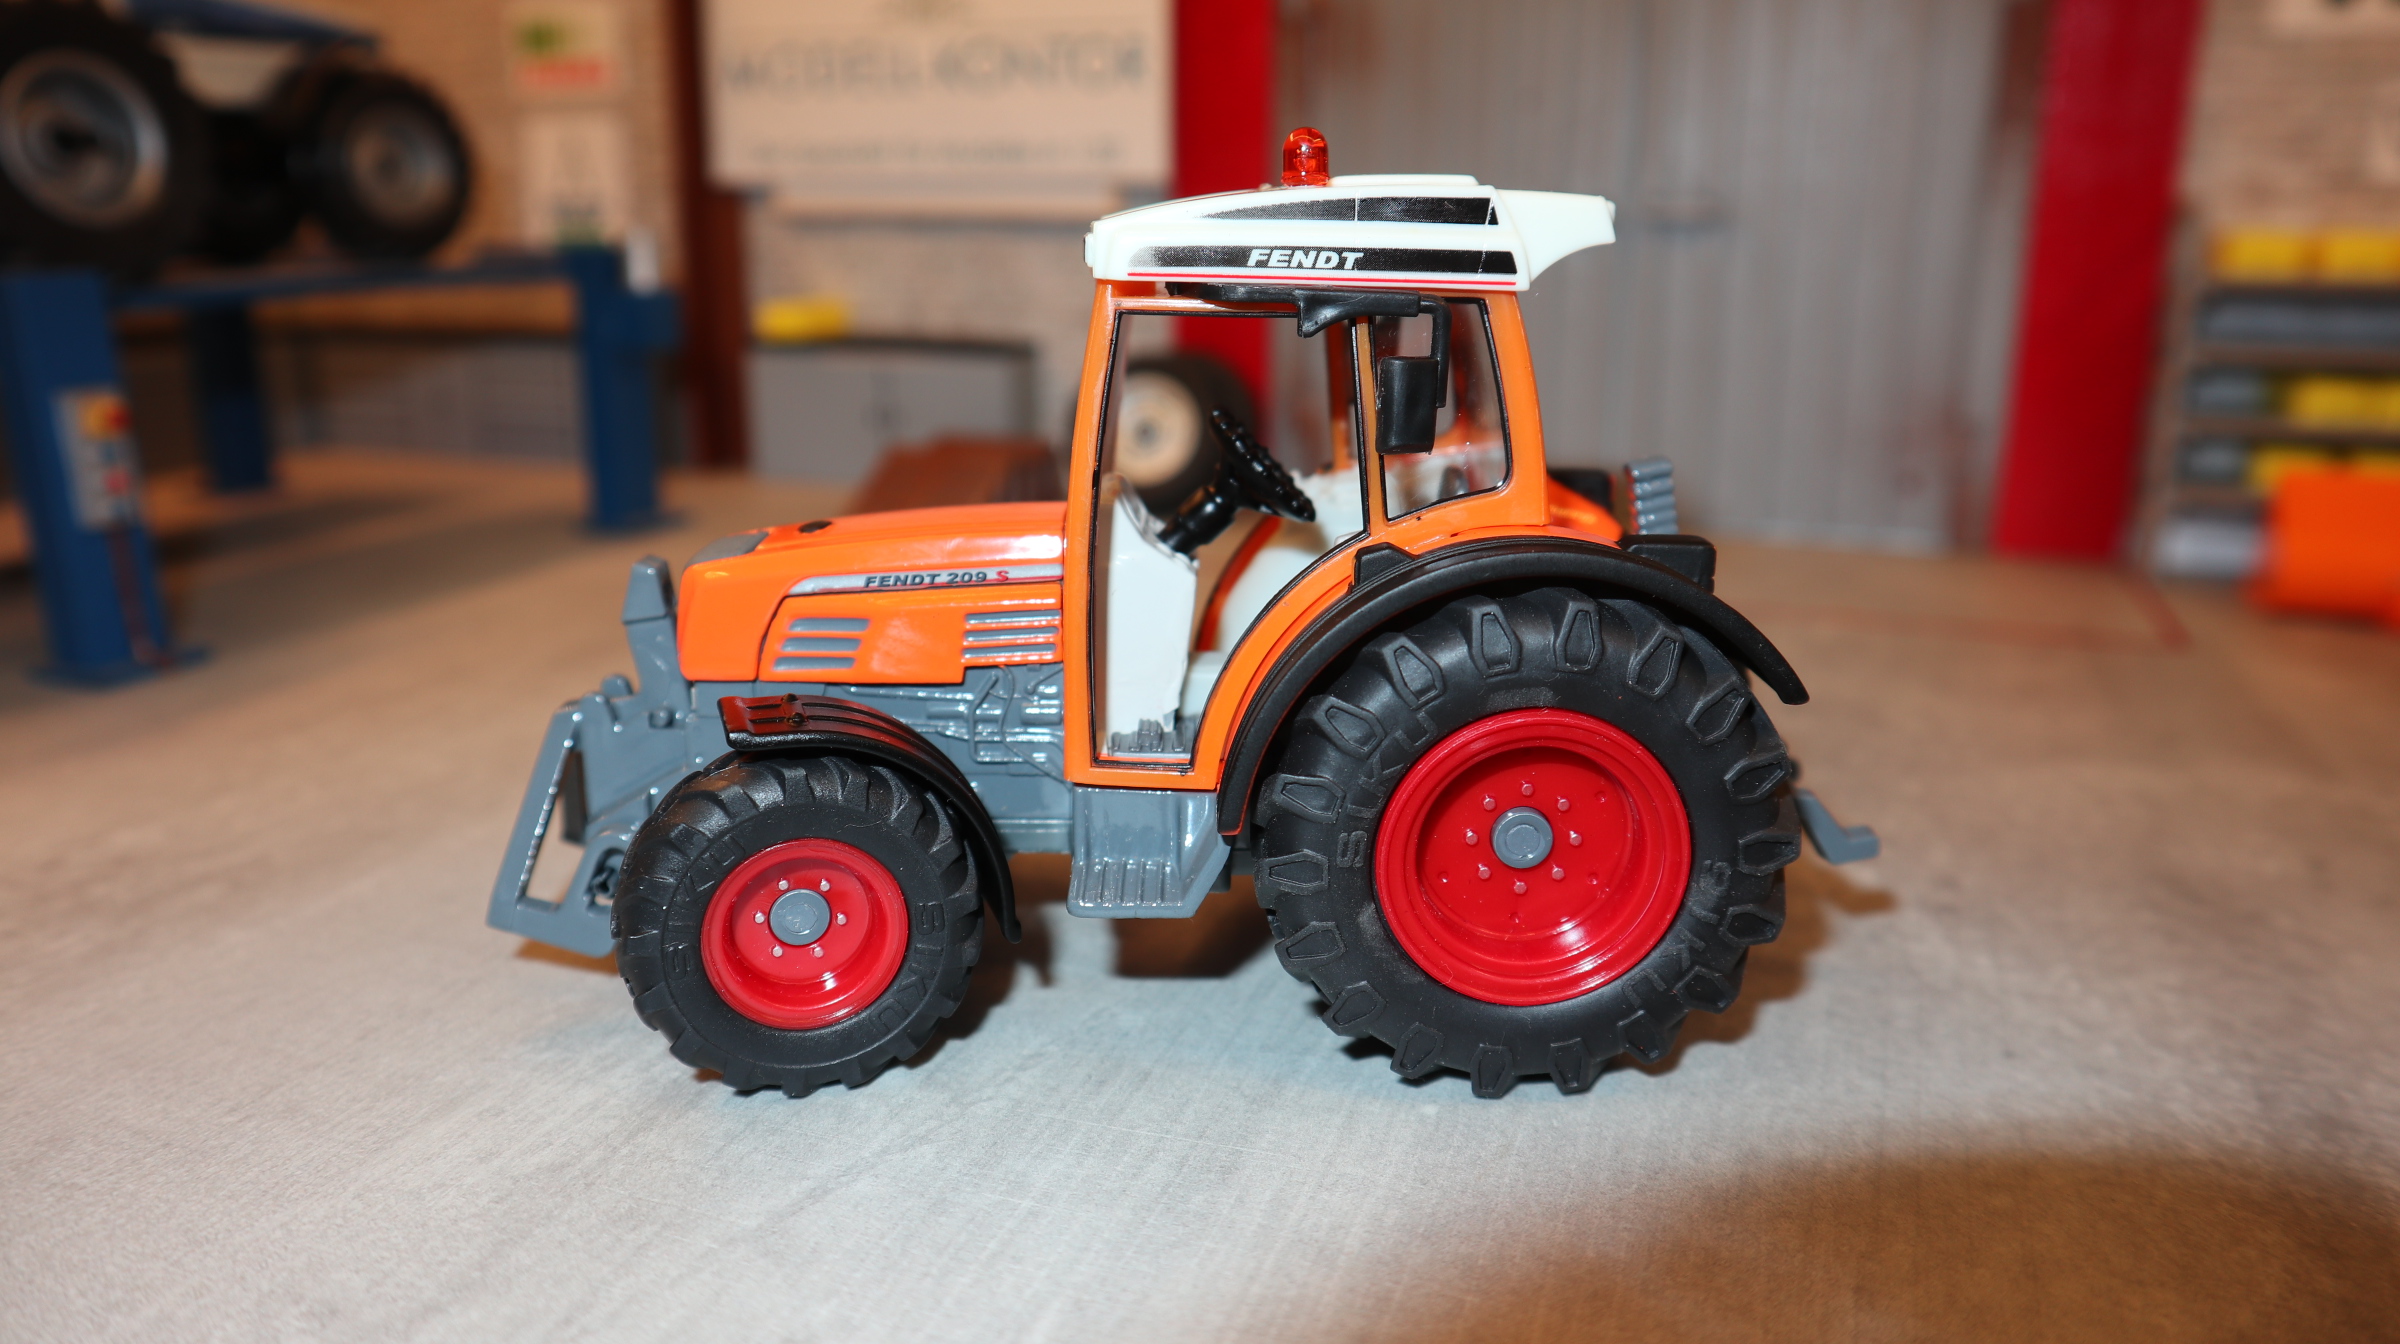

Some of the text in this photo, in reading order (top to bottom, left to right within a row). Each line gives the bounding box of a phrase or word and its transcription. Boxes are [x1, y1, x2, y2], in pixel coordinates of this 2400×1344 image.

[1246, 248, 1365, 270] FENDT
[863, 570, 1009, 588] FENDT 209 S
[1336, 711, 1438, 868] SIKU
[868, 902, 946, 1036] SIKU
